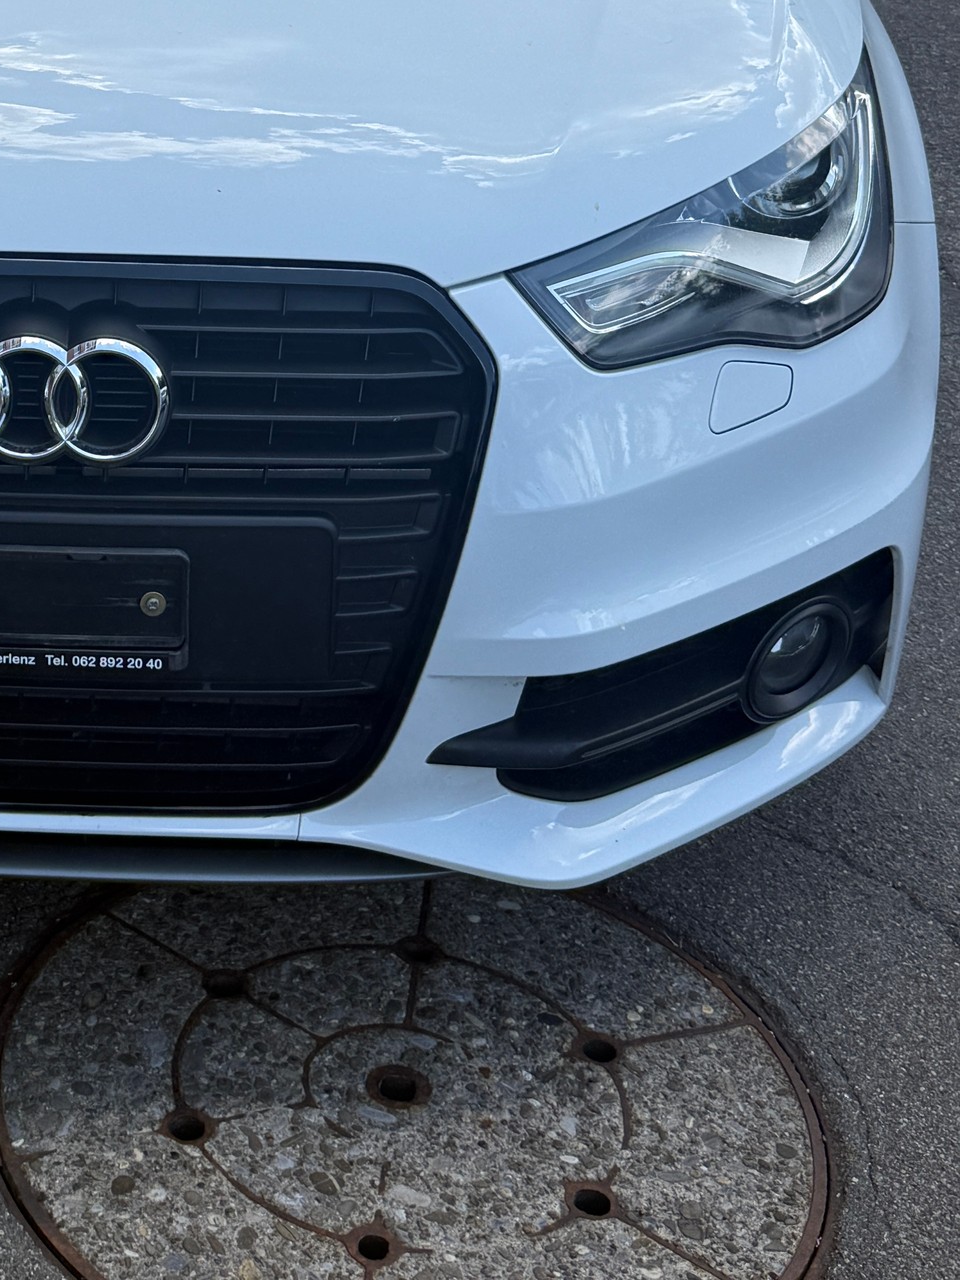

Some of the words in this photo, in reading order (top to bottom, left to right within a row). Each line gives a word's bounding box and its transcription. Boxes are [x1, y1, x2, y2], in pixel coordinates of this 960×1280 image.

[45, 654, 69, 666] Tel.
[71, 655, 96, 667] 062
[99, 656, 124, 668] 892
[127, 658, 143, 669] 20
[145, 658, 163, 670] 40
